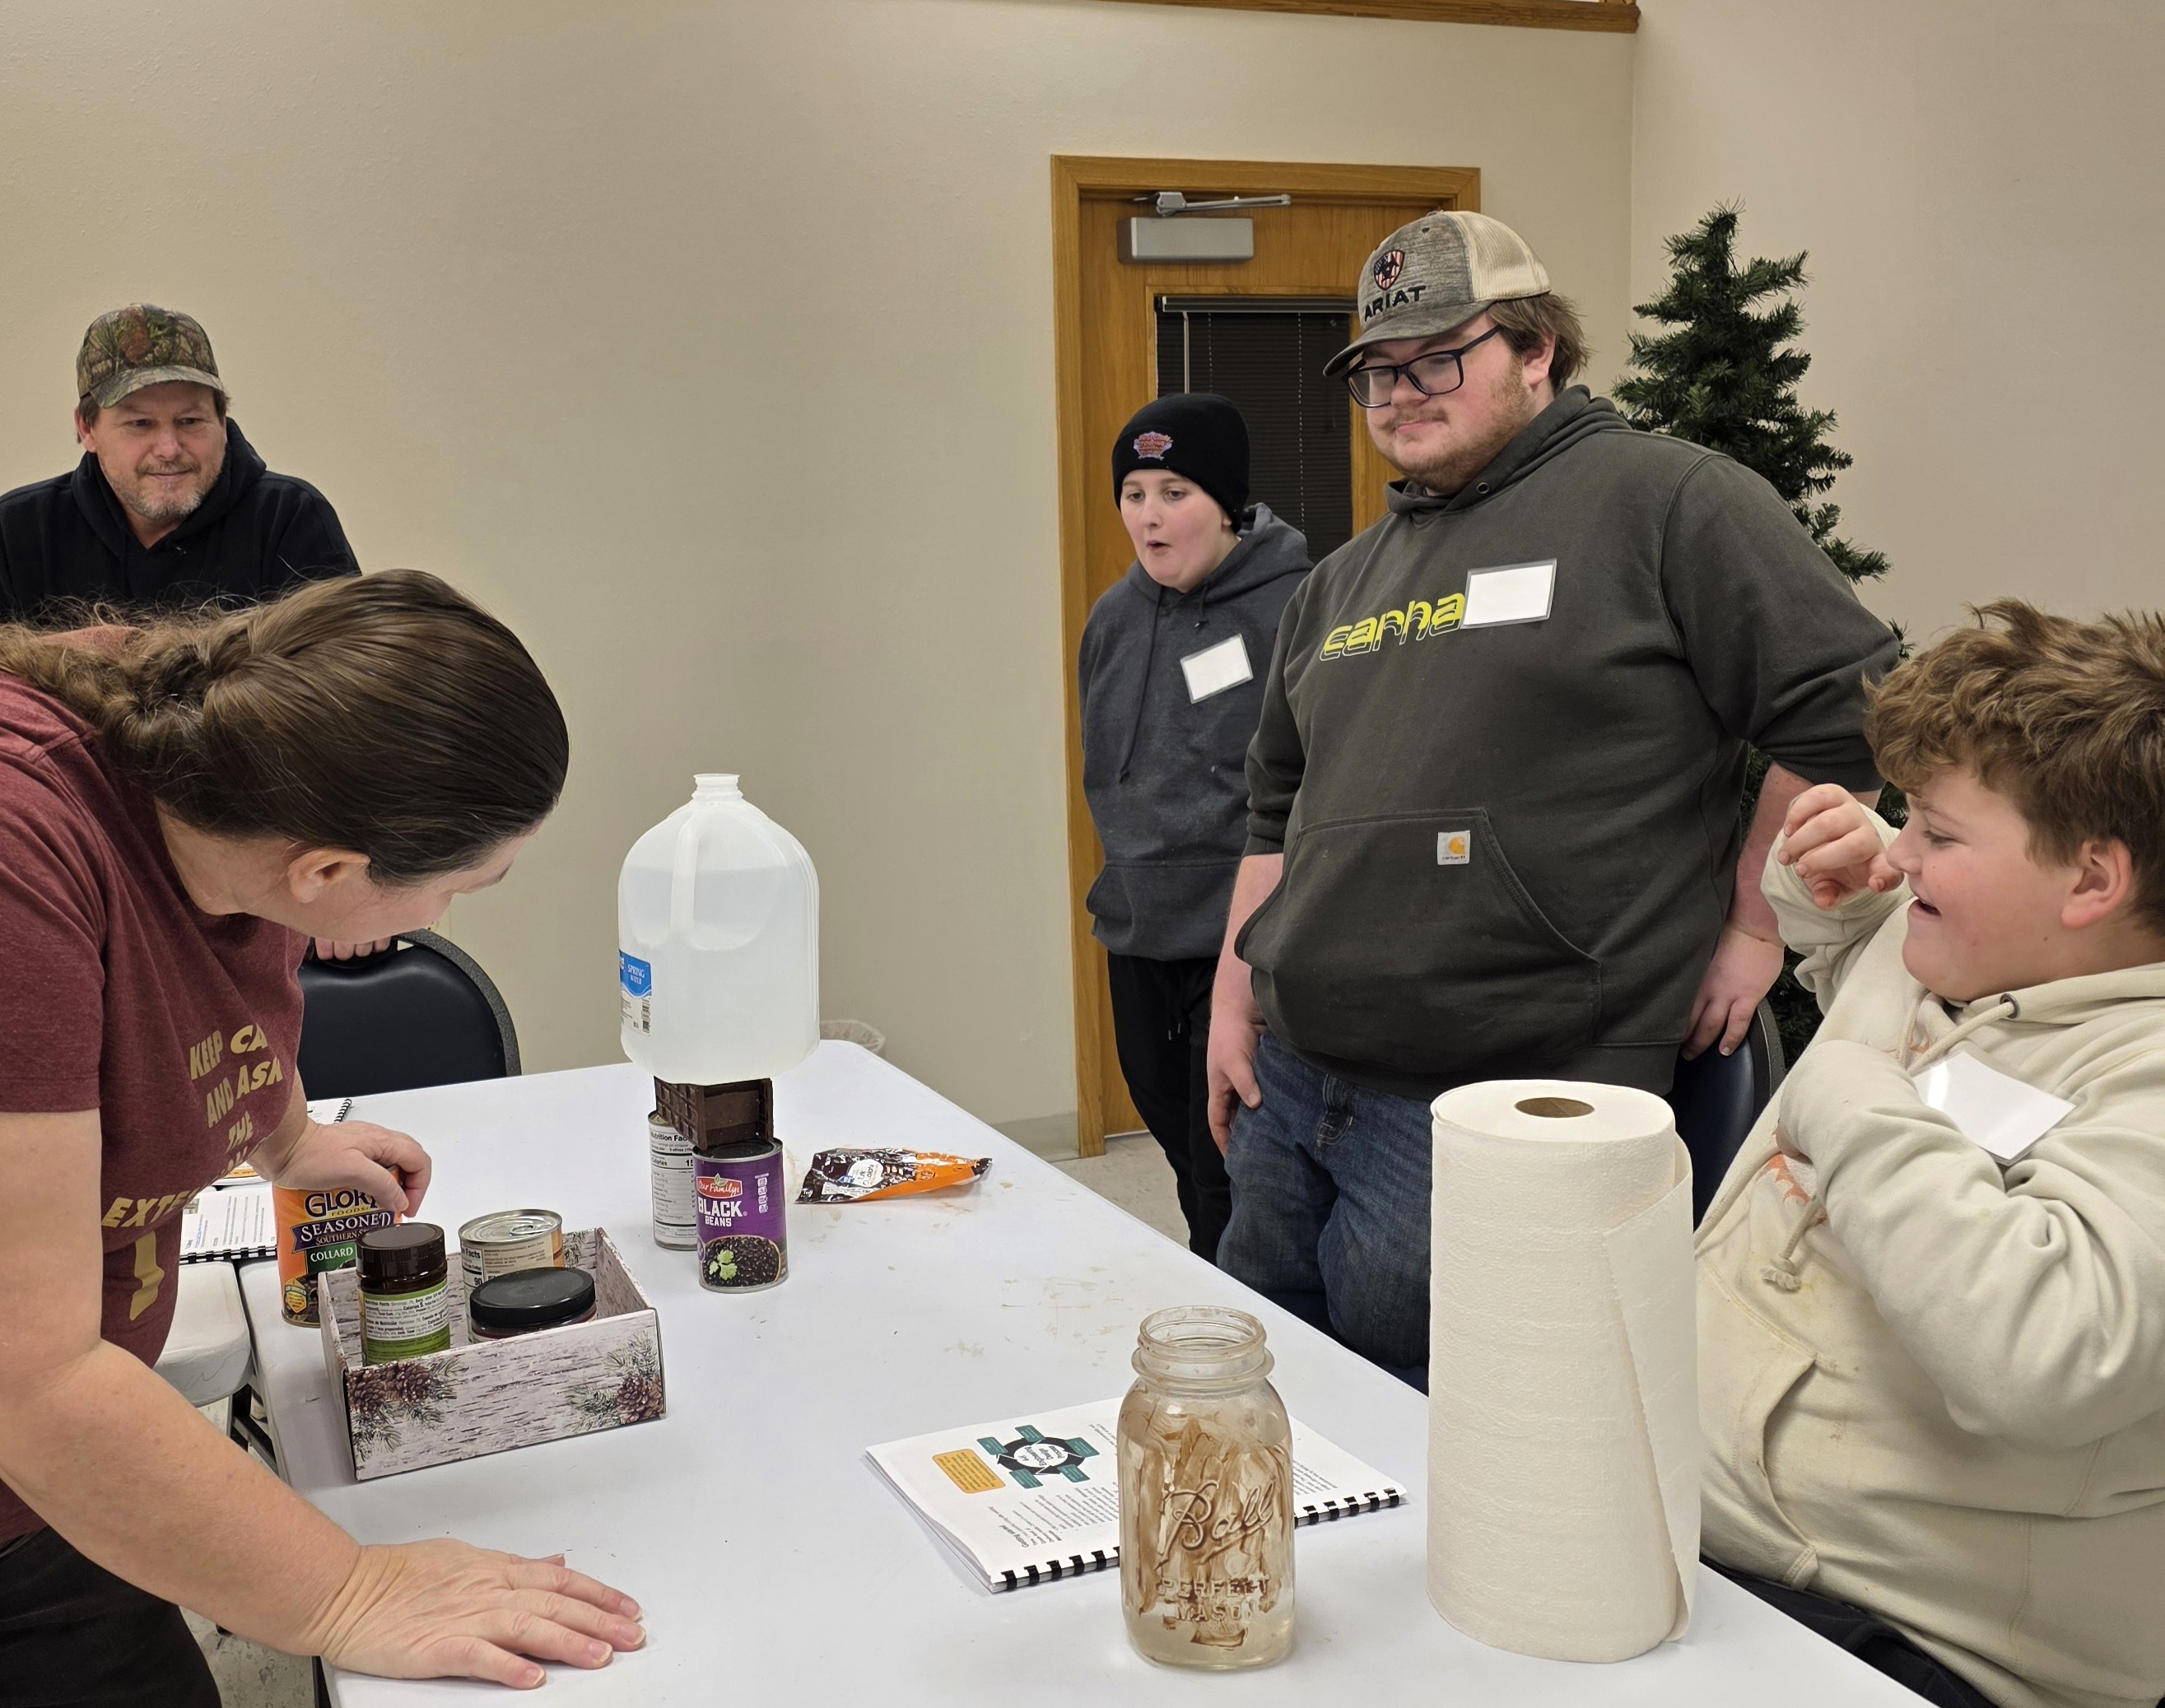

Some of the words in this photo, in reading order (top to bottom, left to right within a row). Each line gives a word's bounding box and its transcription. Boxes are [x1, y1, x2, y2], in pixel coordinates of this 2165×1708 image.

[1364, 286, 1426, 322] ARIAT
[1320, 593, 1465, 661] carha
[190, 1030, 223, 1080] KEEP
[230, 1022, 268, 1054] CA
[207, 1077, 234, 1129] AND
[237, 1057, 284, 1100] ASK
[226, 1110, 254, 1152] THE
[698, 1180, 709, 1190] Our
[710, 1183, 738, 1197] Family
[101, 1188, 198, 1229] EXTE
[698, 1196, 743, 1217] BLACK
[705, 1216, 732, 1226] BEANS
[300, 1212, 391, 1241] SEASONED
[315, 1231, 357, 1245] SOUTHERN
[310, 1247, 353, 1262] COLLARD
[1155, 1480, 1274, 1571] Ball
[1159, 1575, 1270, 1599] PERFECT
[1176, 1603, 1255, 1622] MASON
